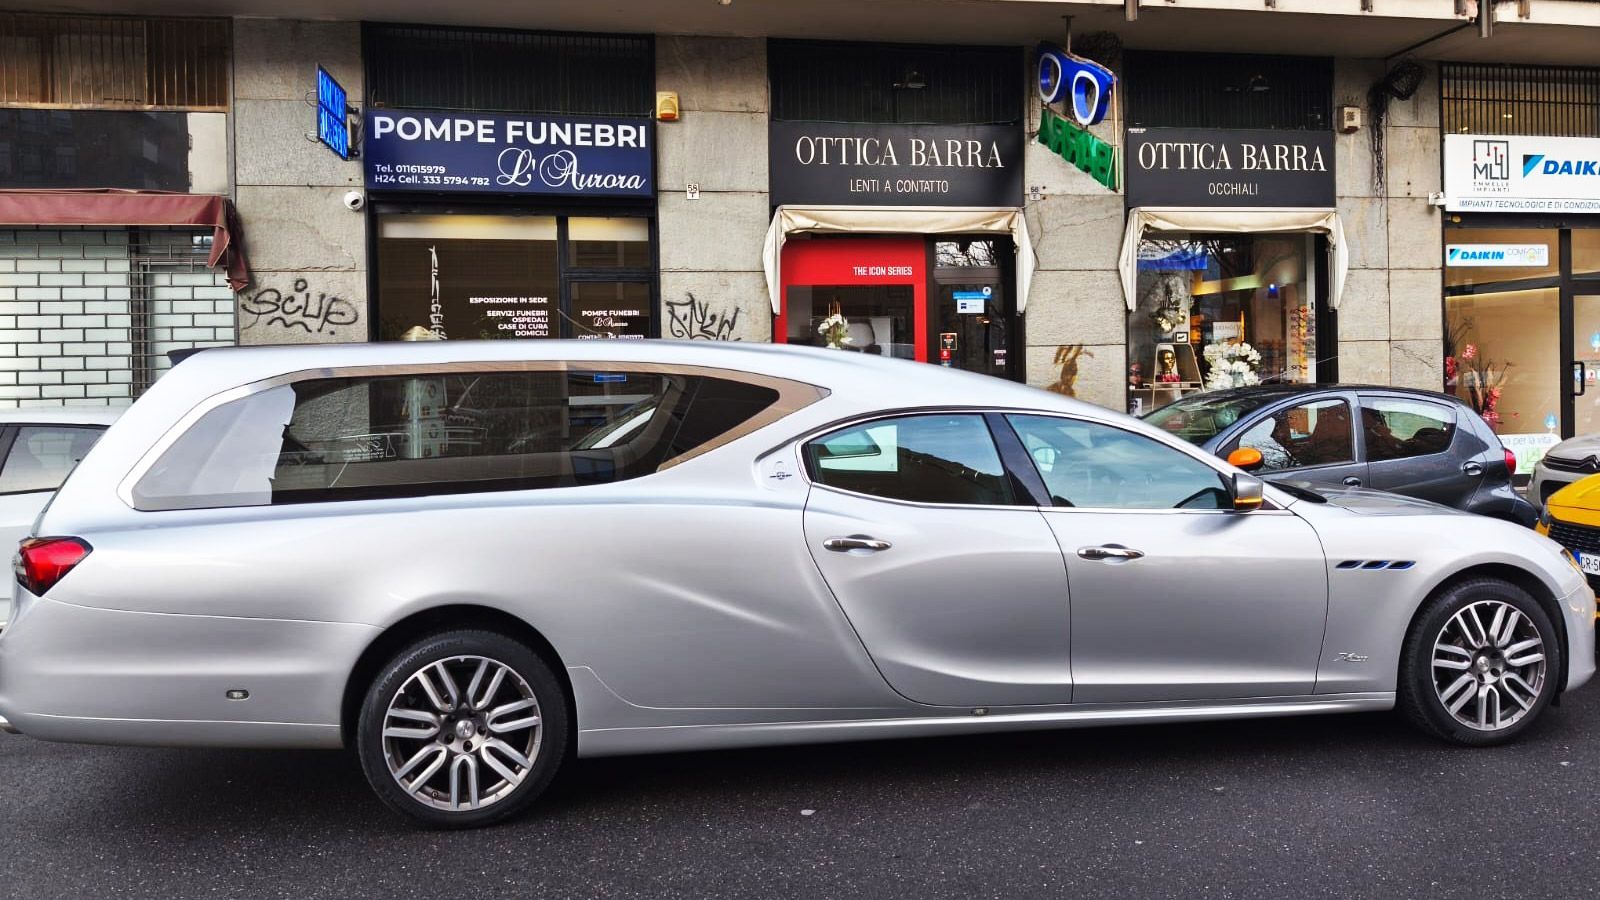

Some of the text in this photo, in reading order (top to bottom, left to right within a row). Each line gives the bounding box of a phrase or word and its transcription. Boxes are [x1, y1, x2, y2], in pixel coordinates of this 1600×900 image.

[374, 116, 496, 143] POMPE
[506, 120, 646, 148] FUNEBRI
[795, 136, 1005, 168] OTTICA BARRA
[1138, 142, 1328, 172] OTTICA BARRA
[375, 164, 446, 174] Tel. 011615979
[1543, 160, 1600, 175] DAIK
[375, 174, 490, 186] H24 Cell. 333 5794 782
[850, 179, 949, 193] LENTI A CONTATTO
[1208, 183, 1258, 195] OCCHIALI
[1459, 200, 1493, 208] IMPIANTI
[1494, 200, 1546, 209] TECNOLOGICI
[1547, 201, 1553, 209] E
[1554, 201, 1562, 209] DI
[1461, 251, 1504, 260] DAIKIN
[853, 266, 913, 276] THE ICON SERIES
